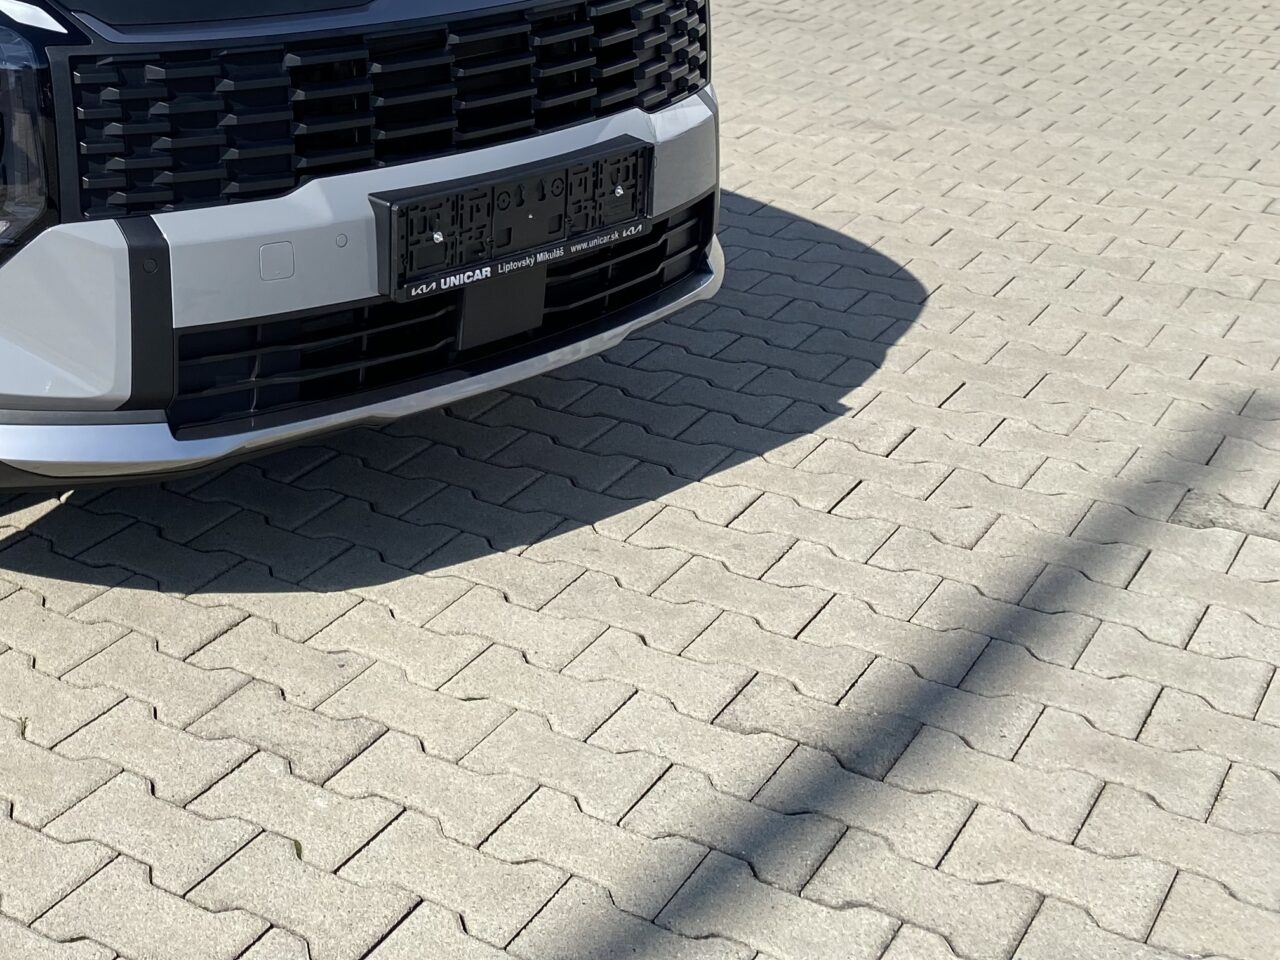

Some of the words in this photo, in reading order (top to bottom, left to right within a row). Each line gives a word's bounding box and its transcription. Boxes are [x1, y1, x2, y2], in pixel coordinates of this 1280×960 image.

[440, 266, 492, 290] UNICAR
[497, 254, 536, 274] Liptovský
[536, 246, 565, 263] Mikuláš
[570, 230, 620, 253] www.unicar.sk
